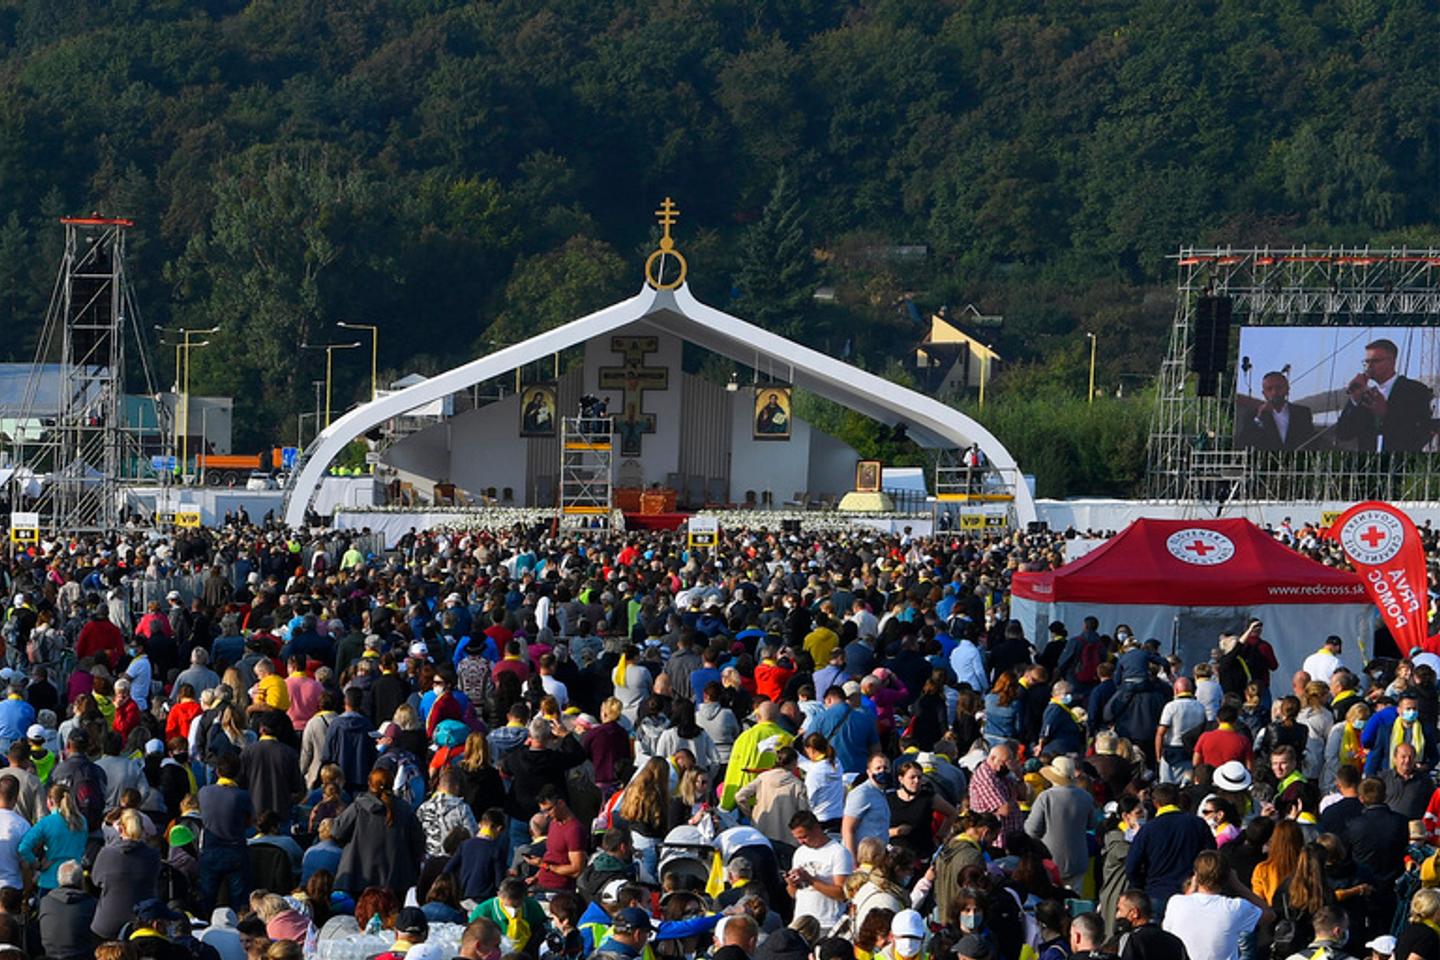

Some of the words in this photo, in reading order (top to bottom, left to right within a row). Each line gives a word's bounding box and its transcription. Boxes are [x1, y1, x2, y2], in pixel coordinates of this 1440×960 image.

[180, 513, 199, 523] VIP
[961, 516, 980, 526] VIP
[1268, 584, 1365, 595] www.redcross.sk
